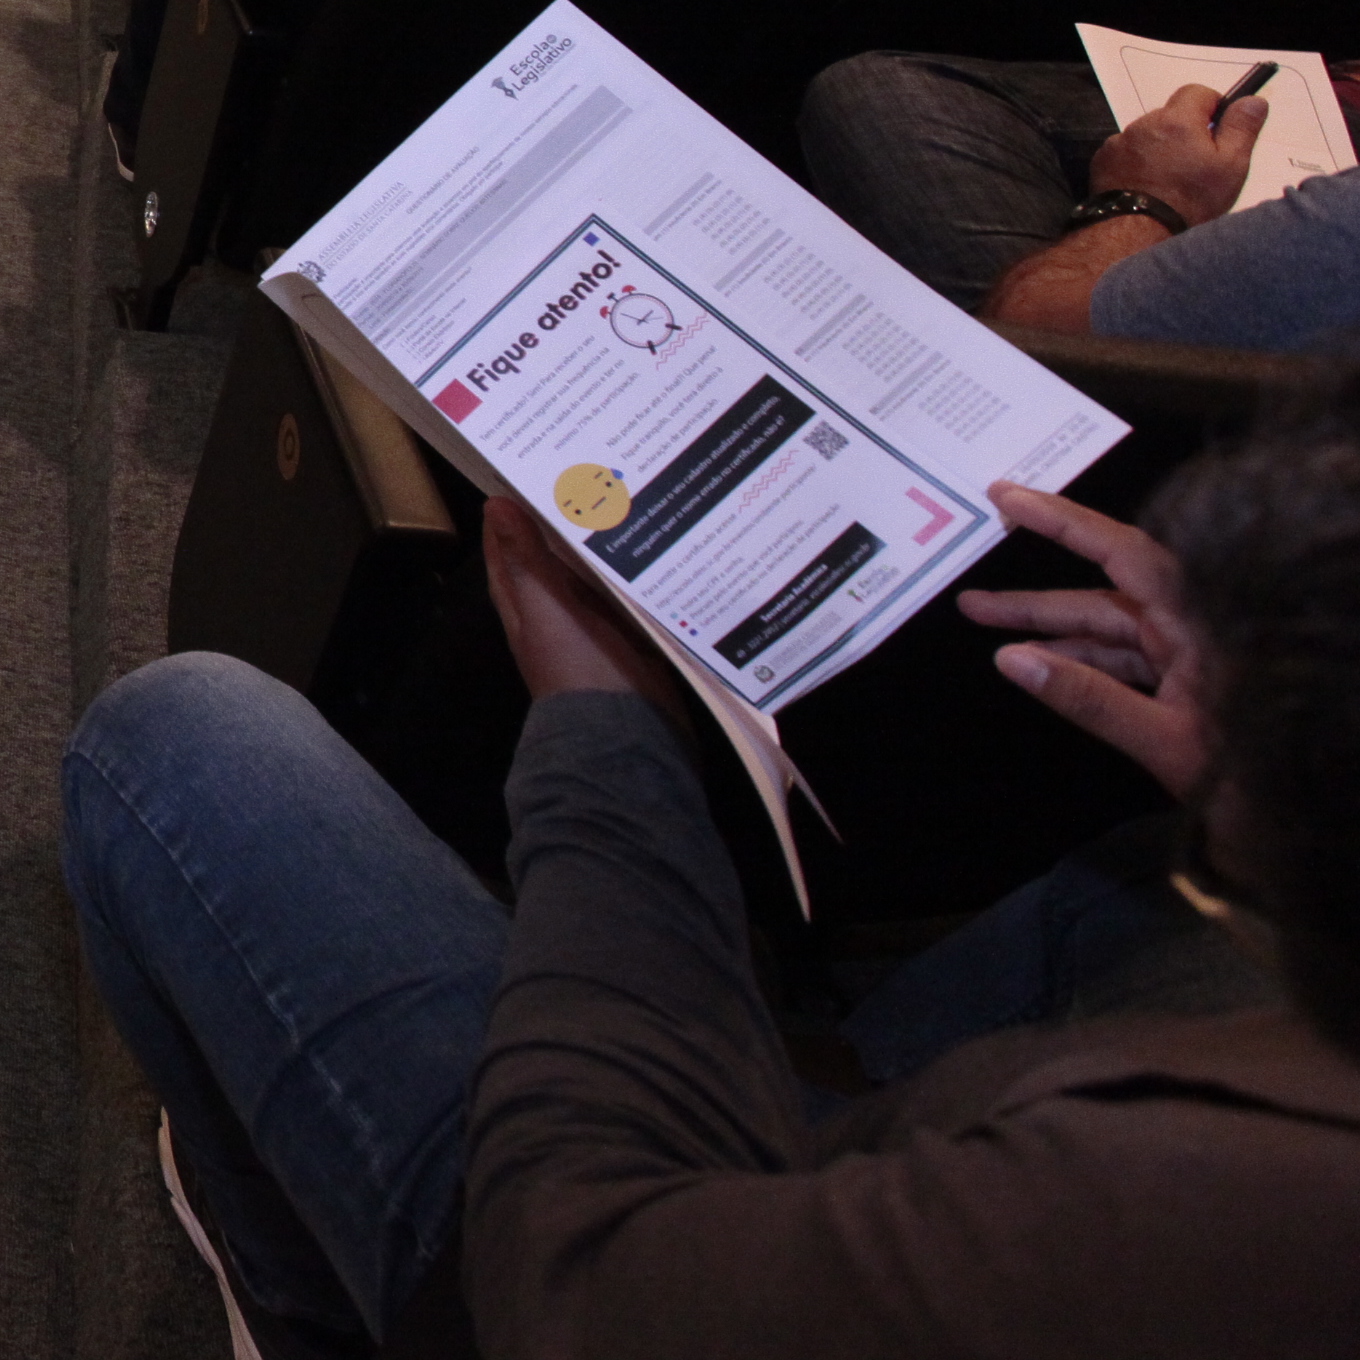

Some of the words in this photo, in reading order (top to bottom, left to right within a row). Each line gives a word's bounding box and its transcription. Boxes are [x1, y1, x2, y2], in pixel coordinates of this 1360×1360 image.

[509, 42, 550, 76] Escola
[511, 38, 572, 91] Legislativo
[466, 332, 539, 391] Fique
[537, 249, 620, 330] atento!
[479, 427, 496, 440] Tem
[494, 395, 527, 429] certificado?
[525, 382, 542, 397] Sim!
[539, 371, 556, 386] Para
[554, 350, 578, 373] receber
[582, 335, 594, 346] seu
[497, 435, 514, 451] você
[511, 416, 534, 438] deverá
[531, 394, 558, 419] registrar
[556, 384, 570, 396] sua
[566, 354, 601, 385] frequência
[599, 346, 610, 356] na
[517, 435, 543, 459] entrada
[545, 423, 556, 432] na
[553, 408, 571, 424] saída
[569, 400, 580, 410] do
[578, 380, 601, 402] evento
[603, 366, 615, 377] ter
[613, 358, 624, 369] no
[576, 414, 593, 429] 75%
[590, 406, 601, 416] de
[605, 434, 621, 447] Não
[619, 418, 638, 437] pode
[634, 406, 651, 420] ficar
[650, 395, 662, 408] até
[682, 361, 699, 376] Que
[619, 442, 641, 460] Fique
[668, 400, 685, 417] você
[682, 389, 698, 403] terá
[696, 371, 718, 391] direito
[611, 514, 649, 548] importante
[647, 497, 668, 517] deixar
[672, 482, 686, 494] seu
[683, 457, 712, 484] cadastro
[710, 428, 744, 459] atualizado
[636, 440, 671, 473] declaração
[669, 432, 679, 442] de
[631, 529, 662, 557] ninguém
[660, 515, 677, 532] quer
[680, 494, 701, 513] nome
[699, 474, 722, 496] errado
[720, 466, 731, 477] no
[640, 583, 659, 598] Para
[656, 566, 678, 586] emitir
[681, 532, 717, 564] certificado
